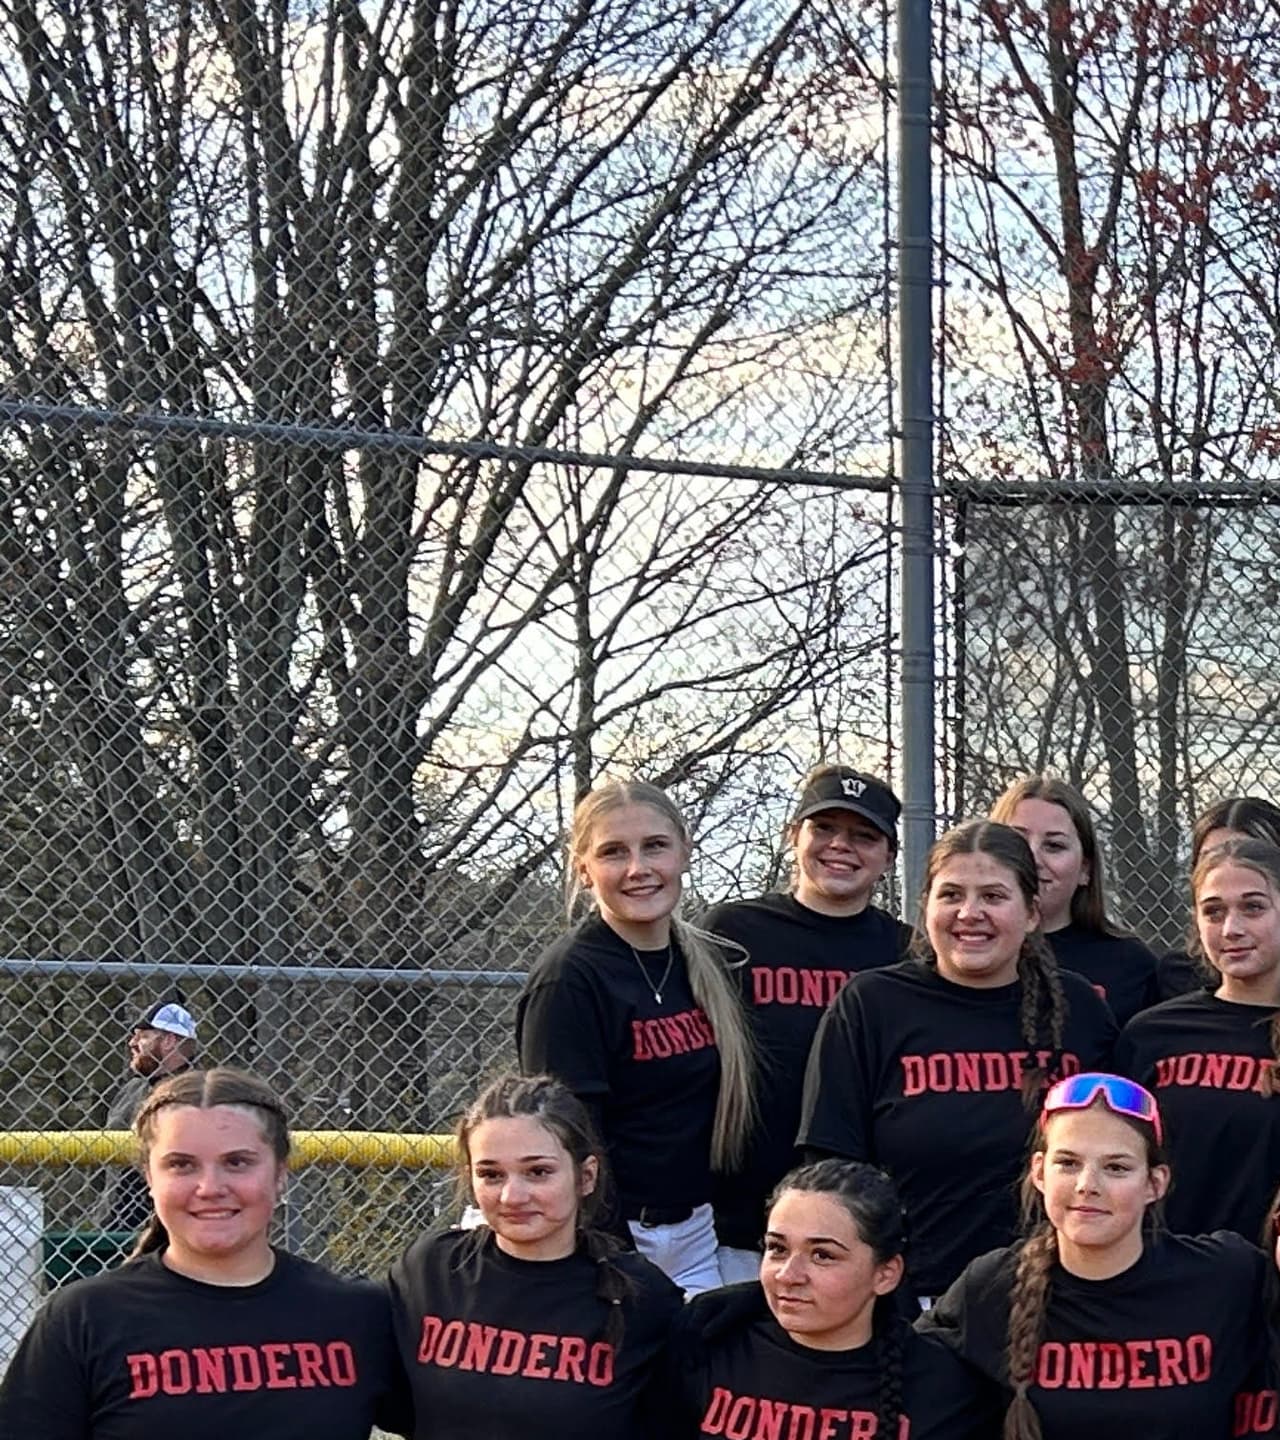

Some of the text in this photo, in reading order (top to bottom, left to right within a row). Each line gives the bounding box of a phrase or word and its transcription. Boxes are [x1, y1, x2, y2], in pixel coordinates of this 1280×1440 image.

[127, 1341, 356, 1399] DONDERO
[417, 1315, 613, 1387] DONDERO
[1033, 1334, 1212, 1390] ONDERO
